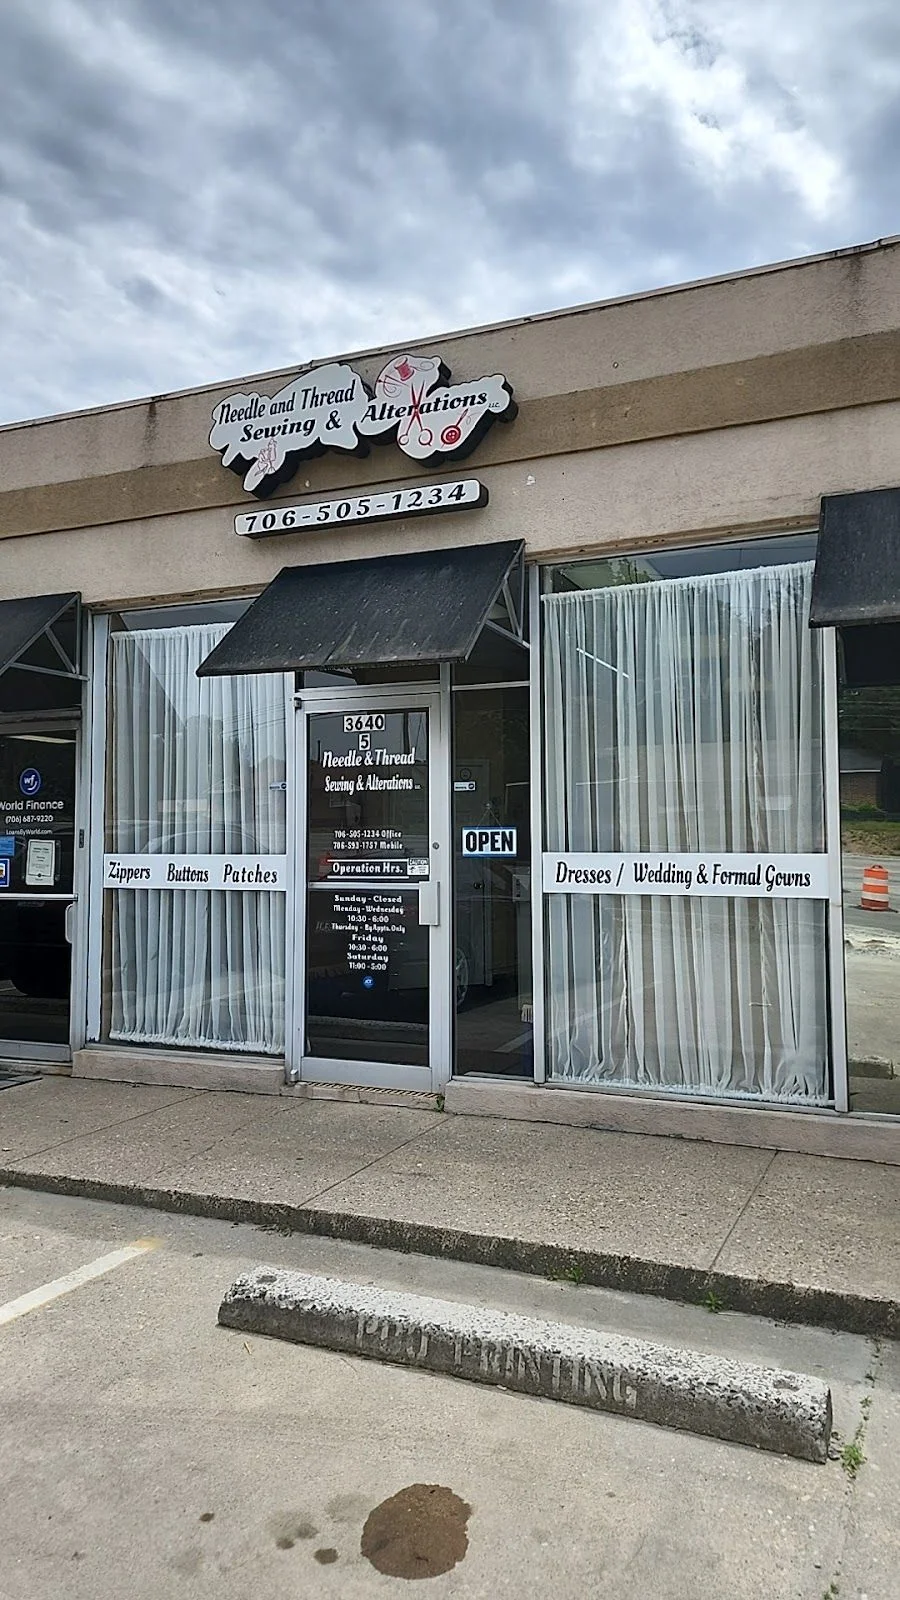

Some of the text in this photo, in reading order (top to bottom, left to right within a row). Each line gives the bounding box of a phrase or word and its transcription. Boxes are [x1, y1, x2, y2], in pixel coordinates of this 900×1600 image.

[219, 379, 356, 426] Needle and Thread
[240, 416, 316, 444] Sewing
[325, 410, 342, 431] &
[361, 389, 488, 424] Alterations
[245, 483, 466, 533] 706-505-1234
[345, 714, 384, 731] 3640
[360, 734, 369, 749] 5
[322, 746, 416, 768] Needle & Thread
[324, 773, 414, 796] Sewing & Alterations
[26, 800, 64, 810] Finance
[334, 830, 402, 839] 706-505-1234 Office
[379, 841, 403, 850] Mobile
[465, 830, 514, 853] OPEN
[108, 861, 278, 884] Zippers Buttons Patches
[332, 862, 381, 875] Operation
[382, 862, 404, 873] Hrs.
[556, 861, 612, 884] Dresses
[633, 862, 692, 890] Wedding
[696, 863, 709, 885] &
[712, 863, 762, 886] Formal
[765, 864, 811, 892] Gowns
[334, 894, 367, 904] Sunday
[373, 895, 402, 903] Closed
[333, 904, 361, 914] Monday
[365, 905, 404, 915] Wednesday
[347, 914, 367, 922] 10:30
[372, 915, 390, 923] 6:00
[331, 922, 359, 932] Thursday
[352, 933, 384, 944] Friday
[348, 943, 367, 951] 10:30
[371, 944, 388, 952] 6:00
[347, 952, 389, 963] Saturday
[349, 961, 366, 970] 11:00
[370, 962, 387, 970] 5:00
[453, 1334, 637, 1409] PRINTING
